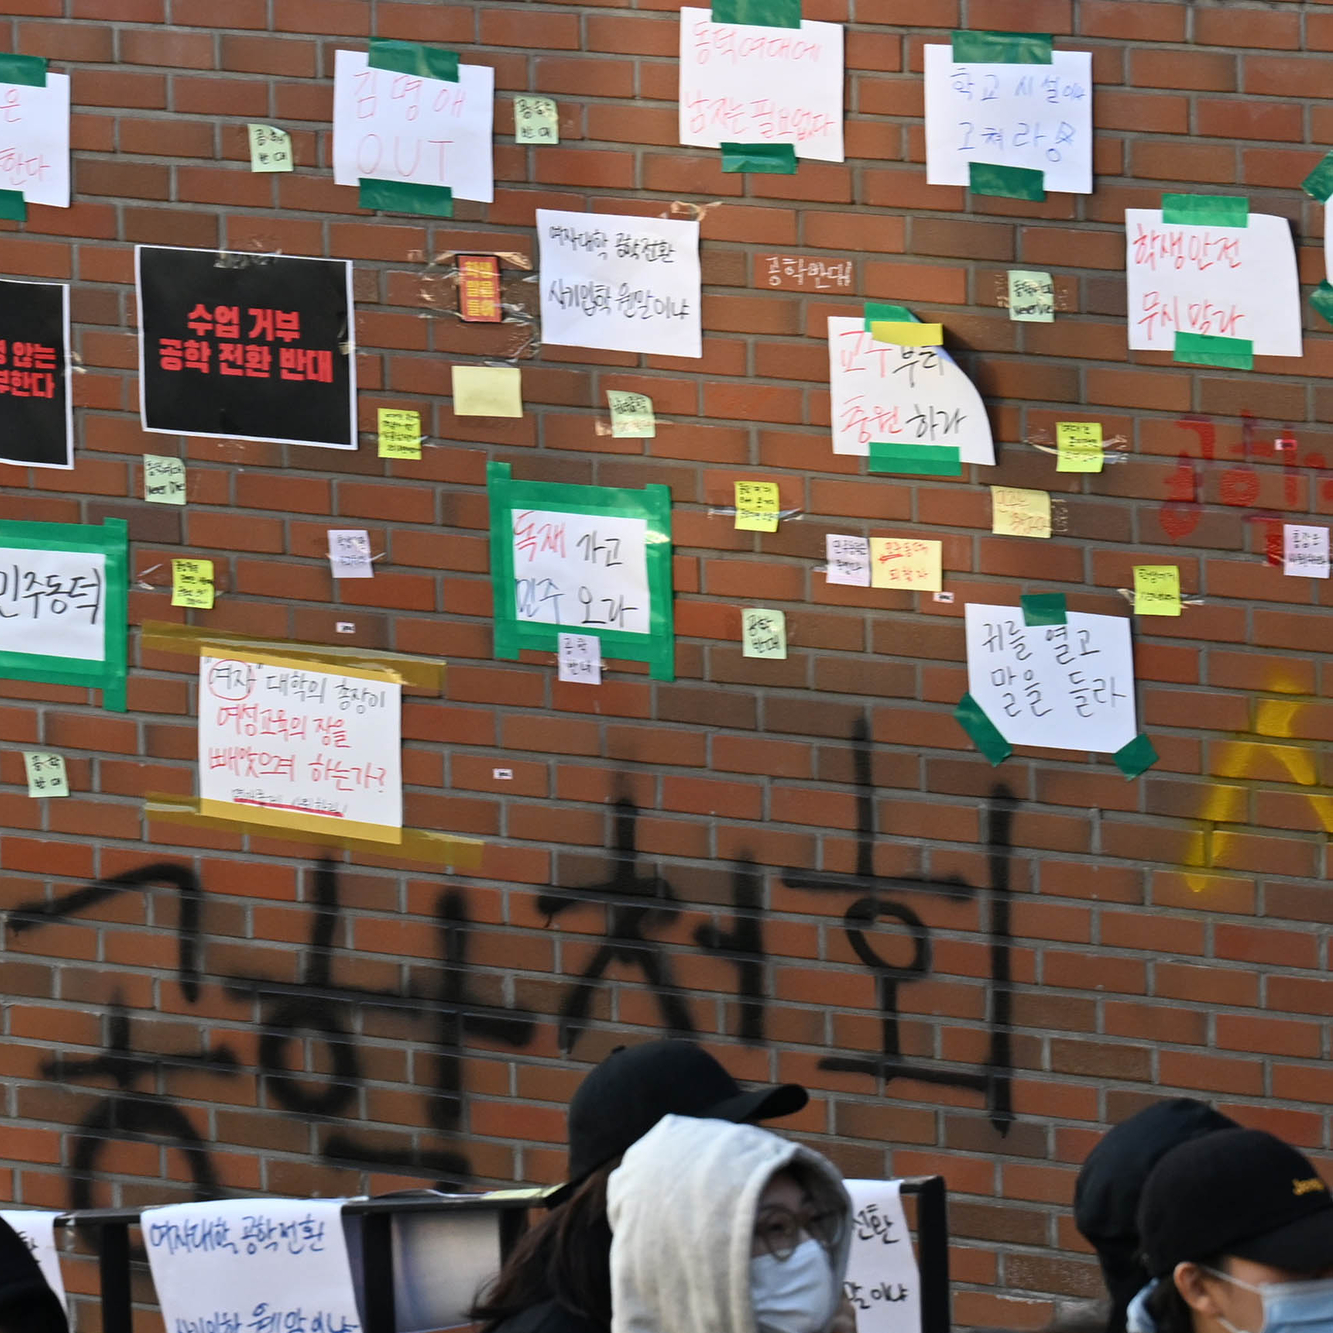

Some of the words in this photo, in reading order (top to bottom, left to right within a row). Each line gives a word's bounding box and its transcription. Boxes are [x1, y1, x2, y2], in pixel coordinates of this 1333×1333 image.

[352, 72, 468, 121] 김명애
[355, 133, 455, 182] OUT
[549, 226, 608, 260] 여자대학
[187, 304, 241, 339] 수업
[247, 308, 302, 342] 거부
[12, 341, 56, 369] 않는
[158, 338, 212, 374] 공학
[219, 344, 271, 378] 전환
[279, 348, 333, 384] 반대
[514, 511, 566, 562] 독재
[576, 530, 623, 567] 가고
[515, 575, 565, 624] 민주
[581, 585, 638, 628] 오라
[983, 620, 1034, 663] 귀를
[1045, 626, 1099, 665] 열고
[266, 673, 326, 704] 대학의
[335, 682, 386, 714] 총장이
[992, 667, 1052, 718] 말을
[1070, 671, 1127, 718] 들라
[313, 714, 351, 749] 장을
[309, 754, 388, 794] 하는가?
[149, 1214, 239, 1257] 여자대학
[240, 1212, 326, 1257] 공학전환
